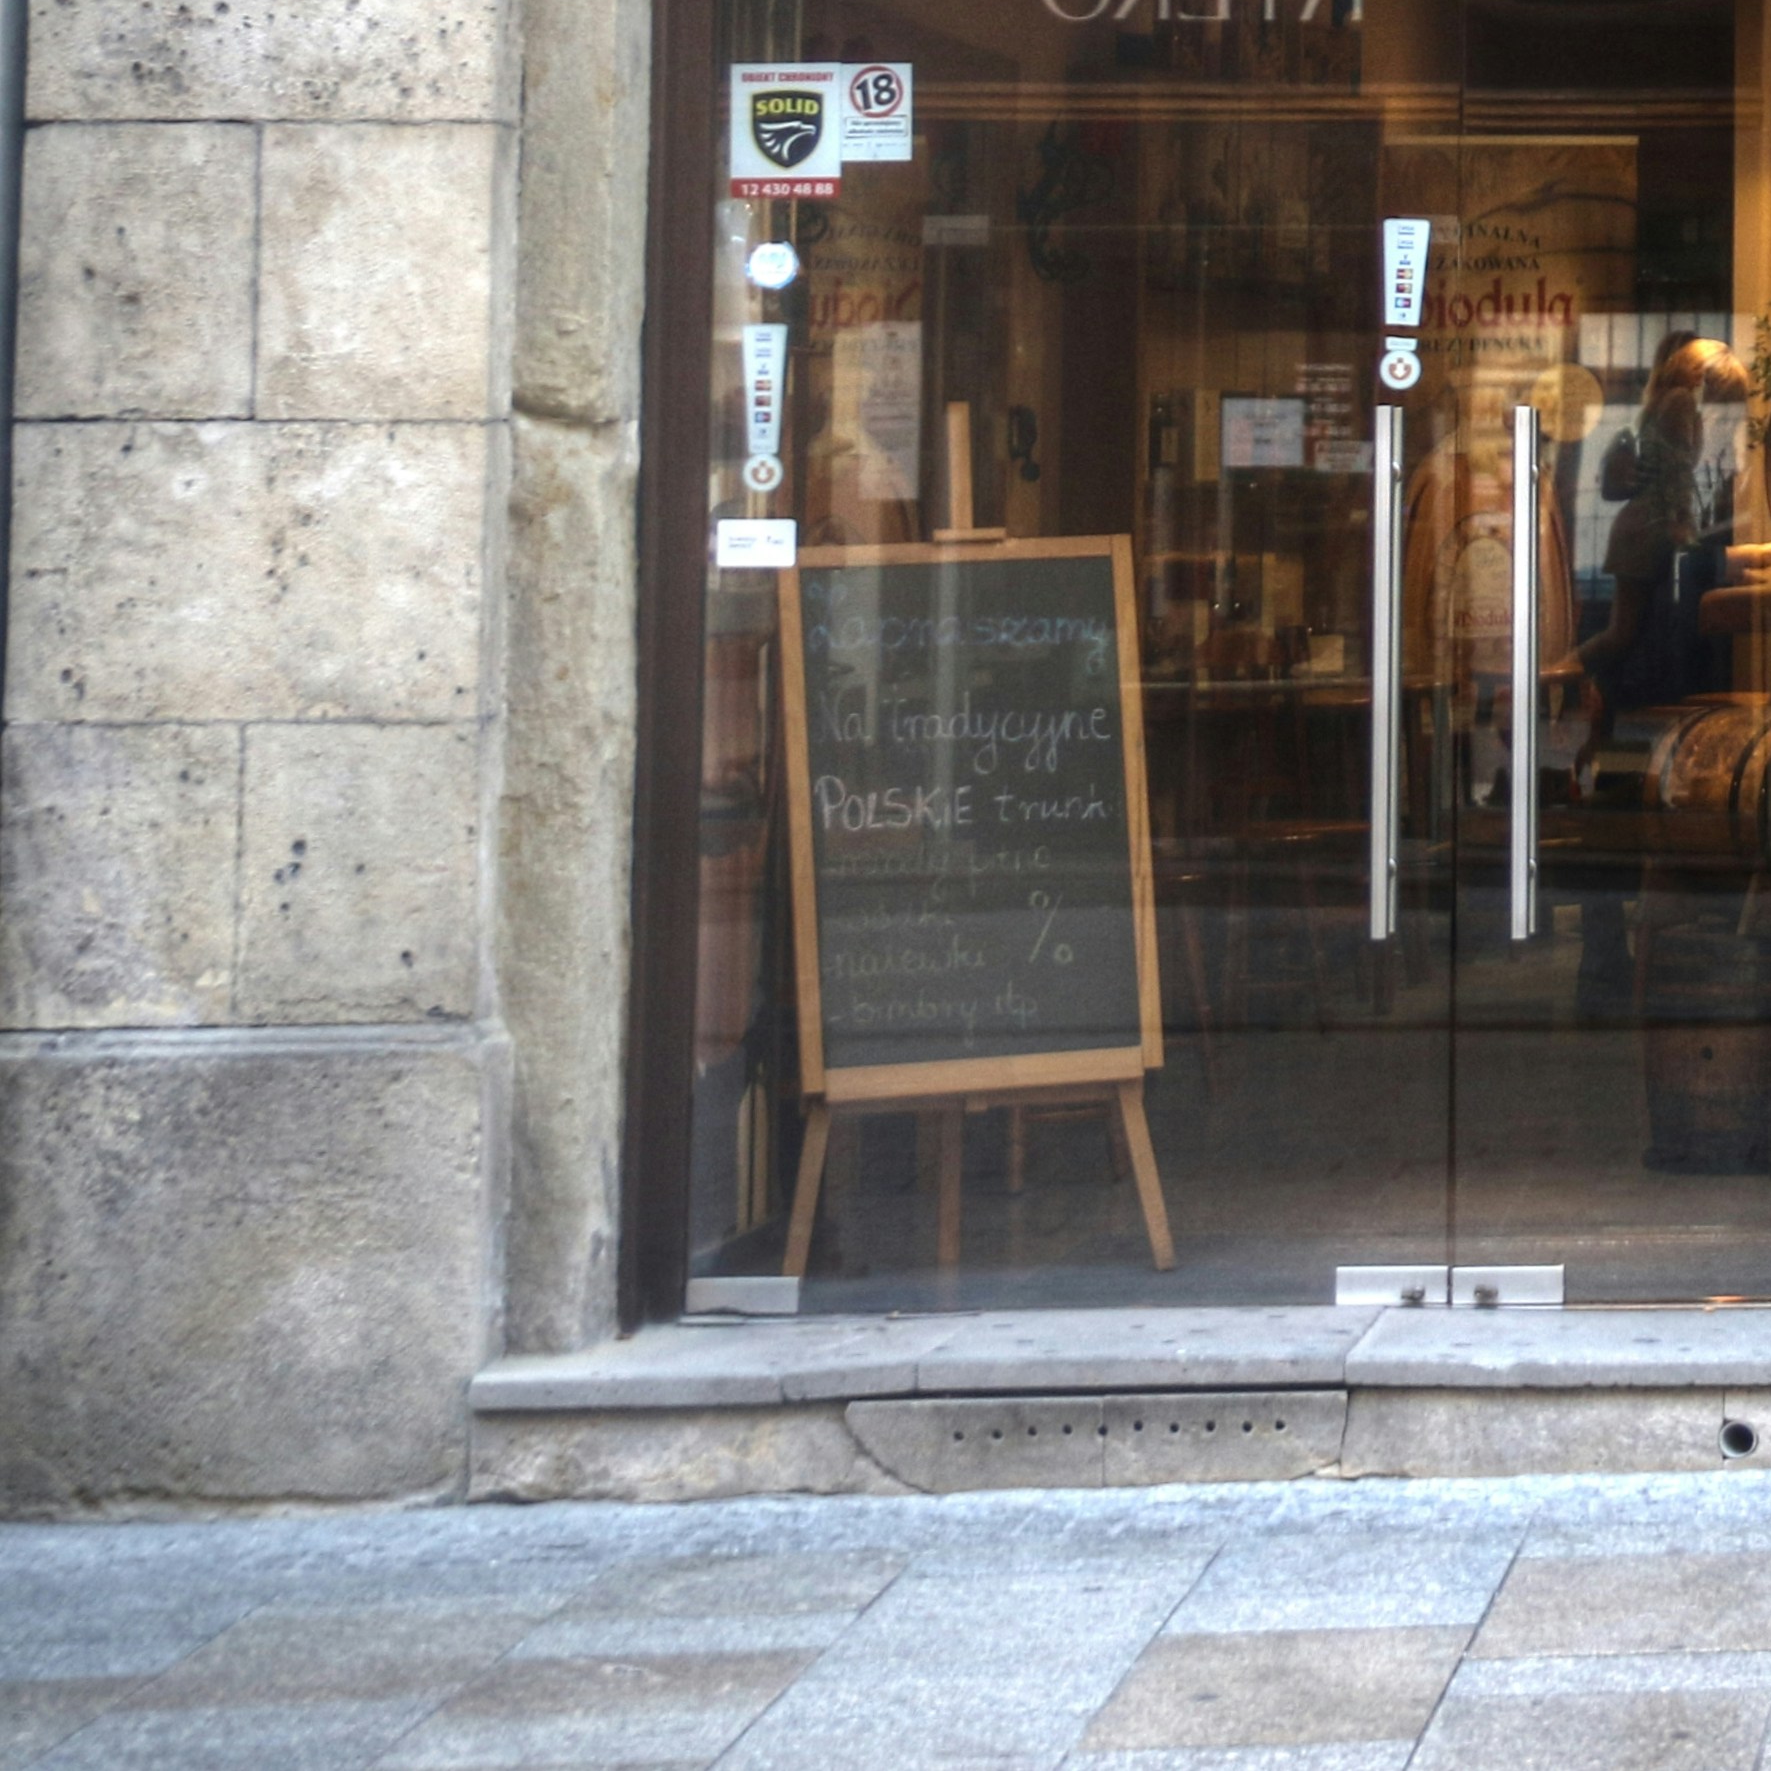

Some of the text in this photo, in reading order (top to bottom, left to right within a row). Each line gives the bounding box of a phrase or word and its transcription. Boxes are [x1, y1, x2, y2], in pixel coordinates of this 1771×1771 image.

[755, 98, 819, 115] SOLID
[855, 73, 897, 111] 18
[741, 183, 759, 195] 12
[762, 183, 790, 195] 430
[793, 183, 812, 195] 48
[882, 685, 1112, 775] tradycyjne
[814, 775, 1121, 831] POLSKIE trunk
